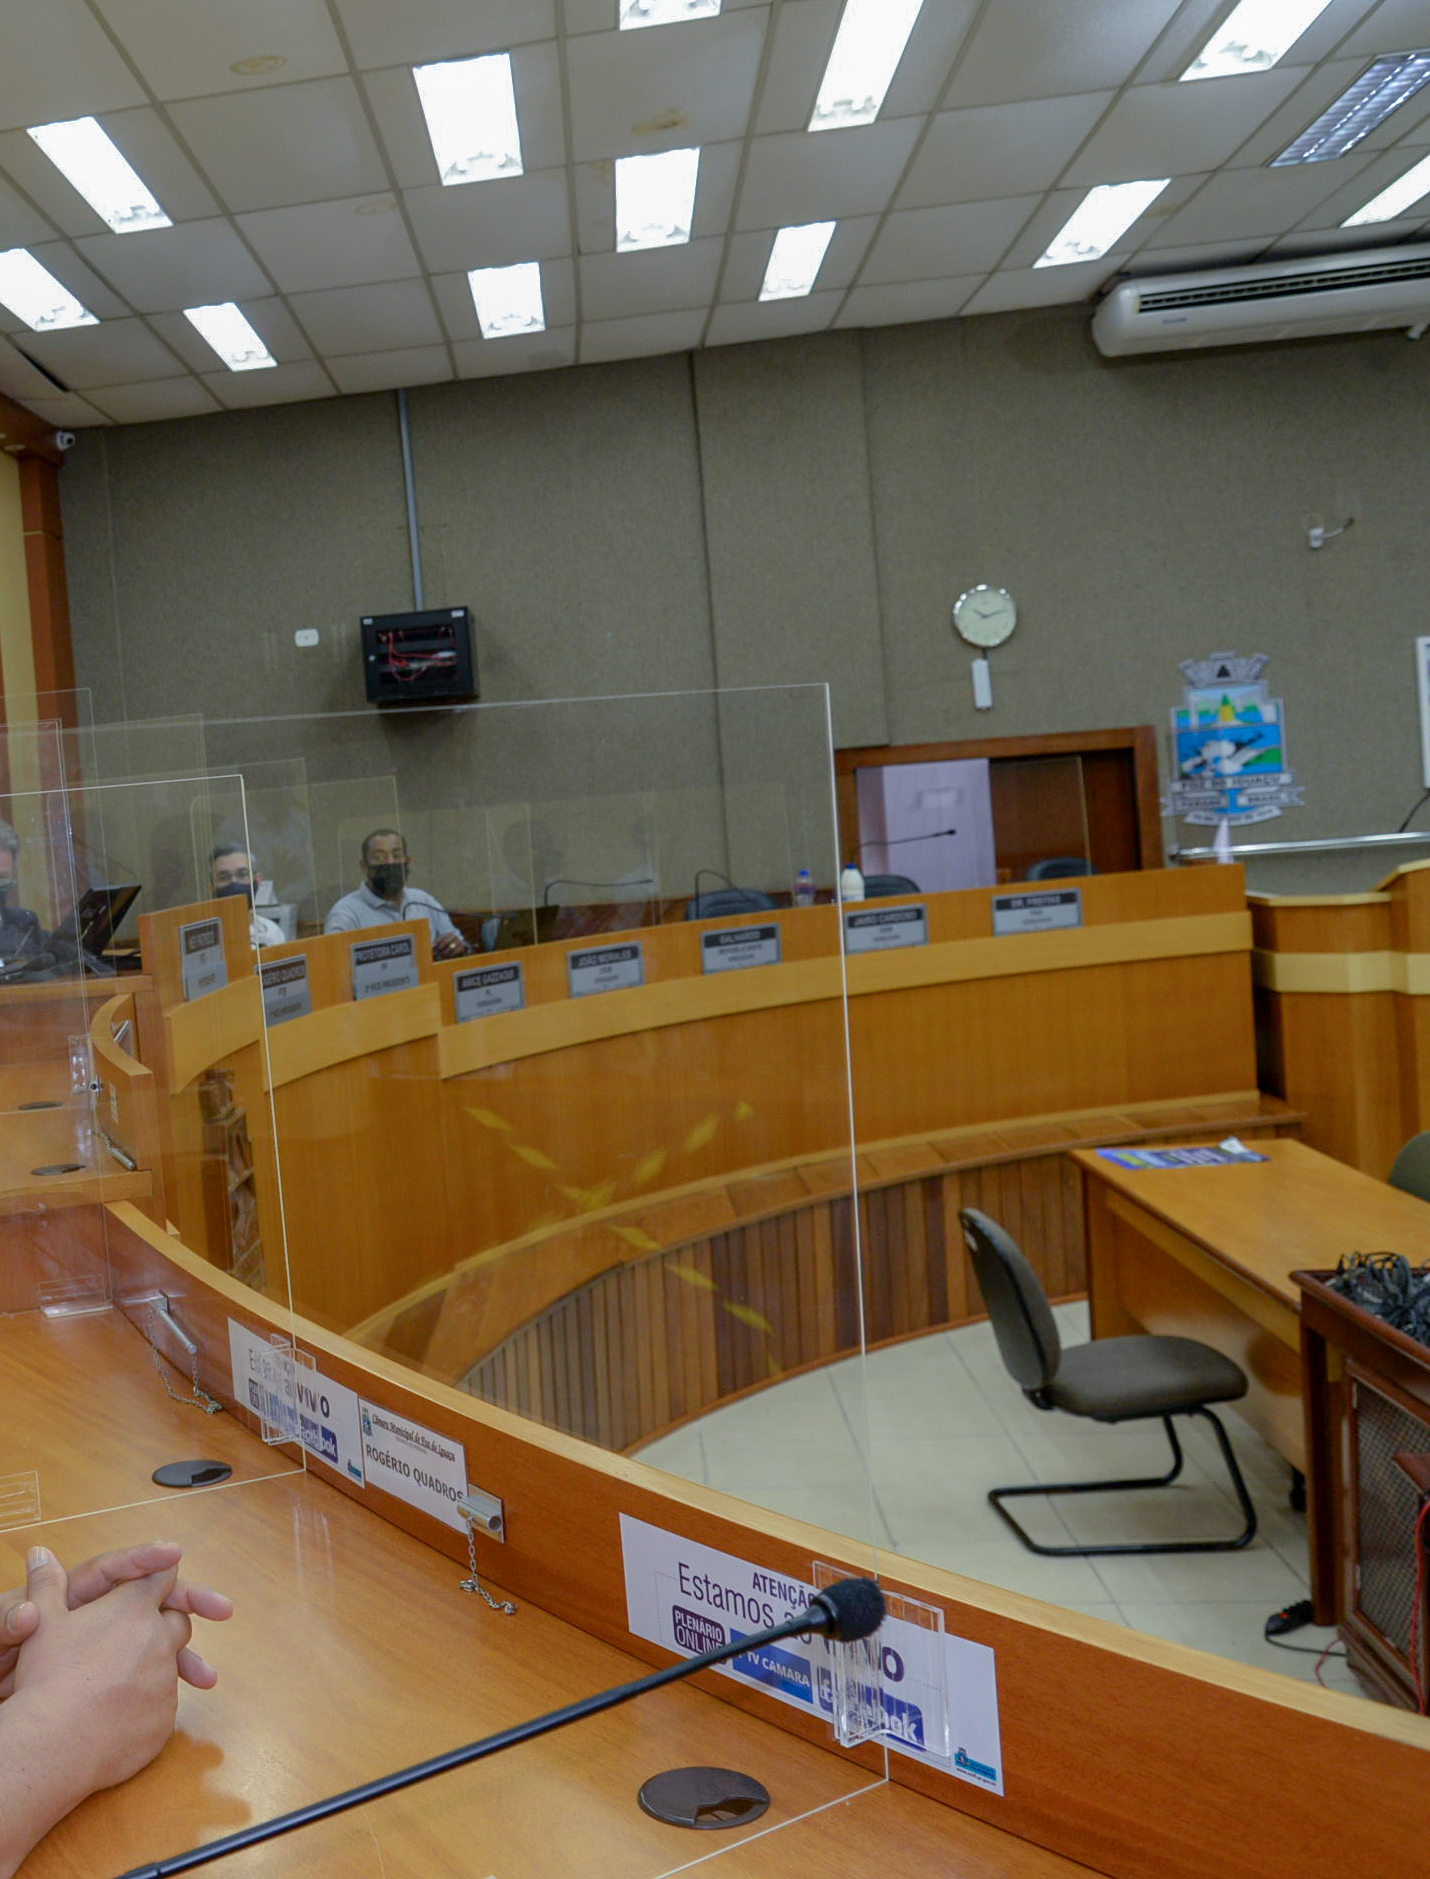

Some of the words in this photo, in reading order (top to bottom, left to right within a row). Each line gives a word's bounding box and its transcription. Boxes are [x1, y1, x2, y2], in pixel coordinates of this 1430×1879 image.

[365, 1444, 411, 1478] ROGÉRIO
[678, 1561, 775, 1630] Estamos
[675, 1609, 723, 1643] PLENÁRIO
[762, 1656, 811, 1689] CÂMARA
